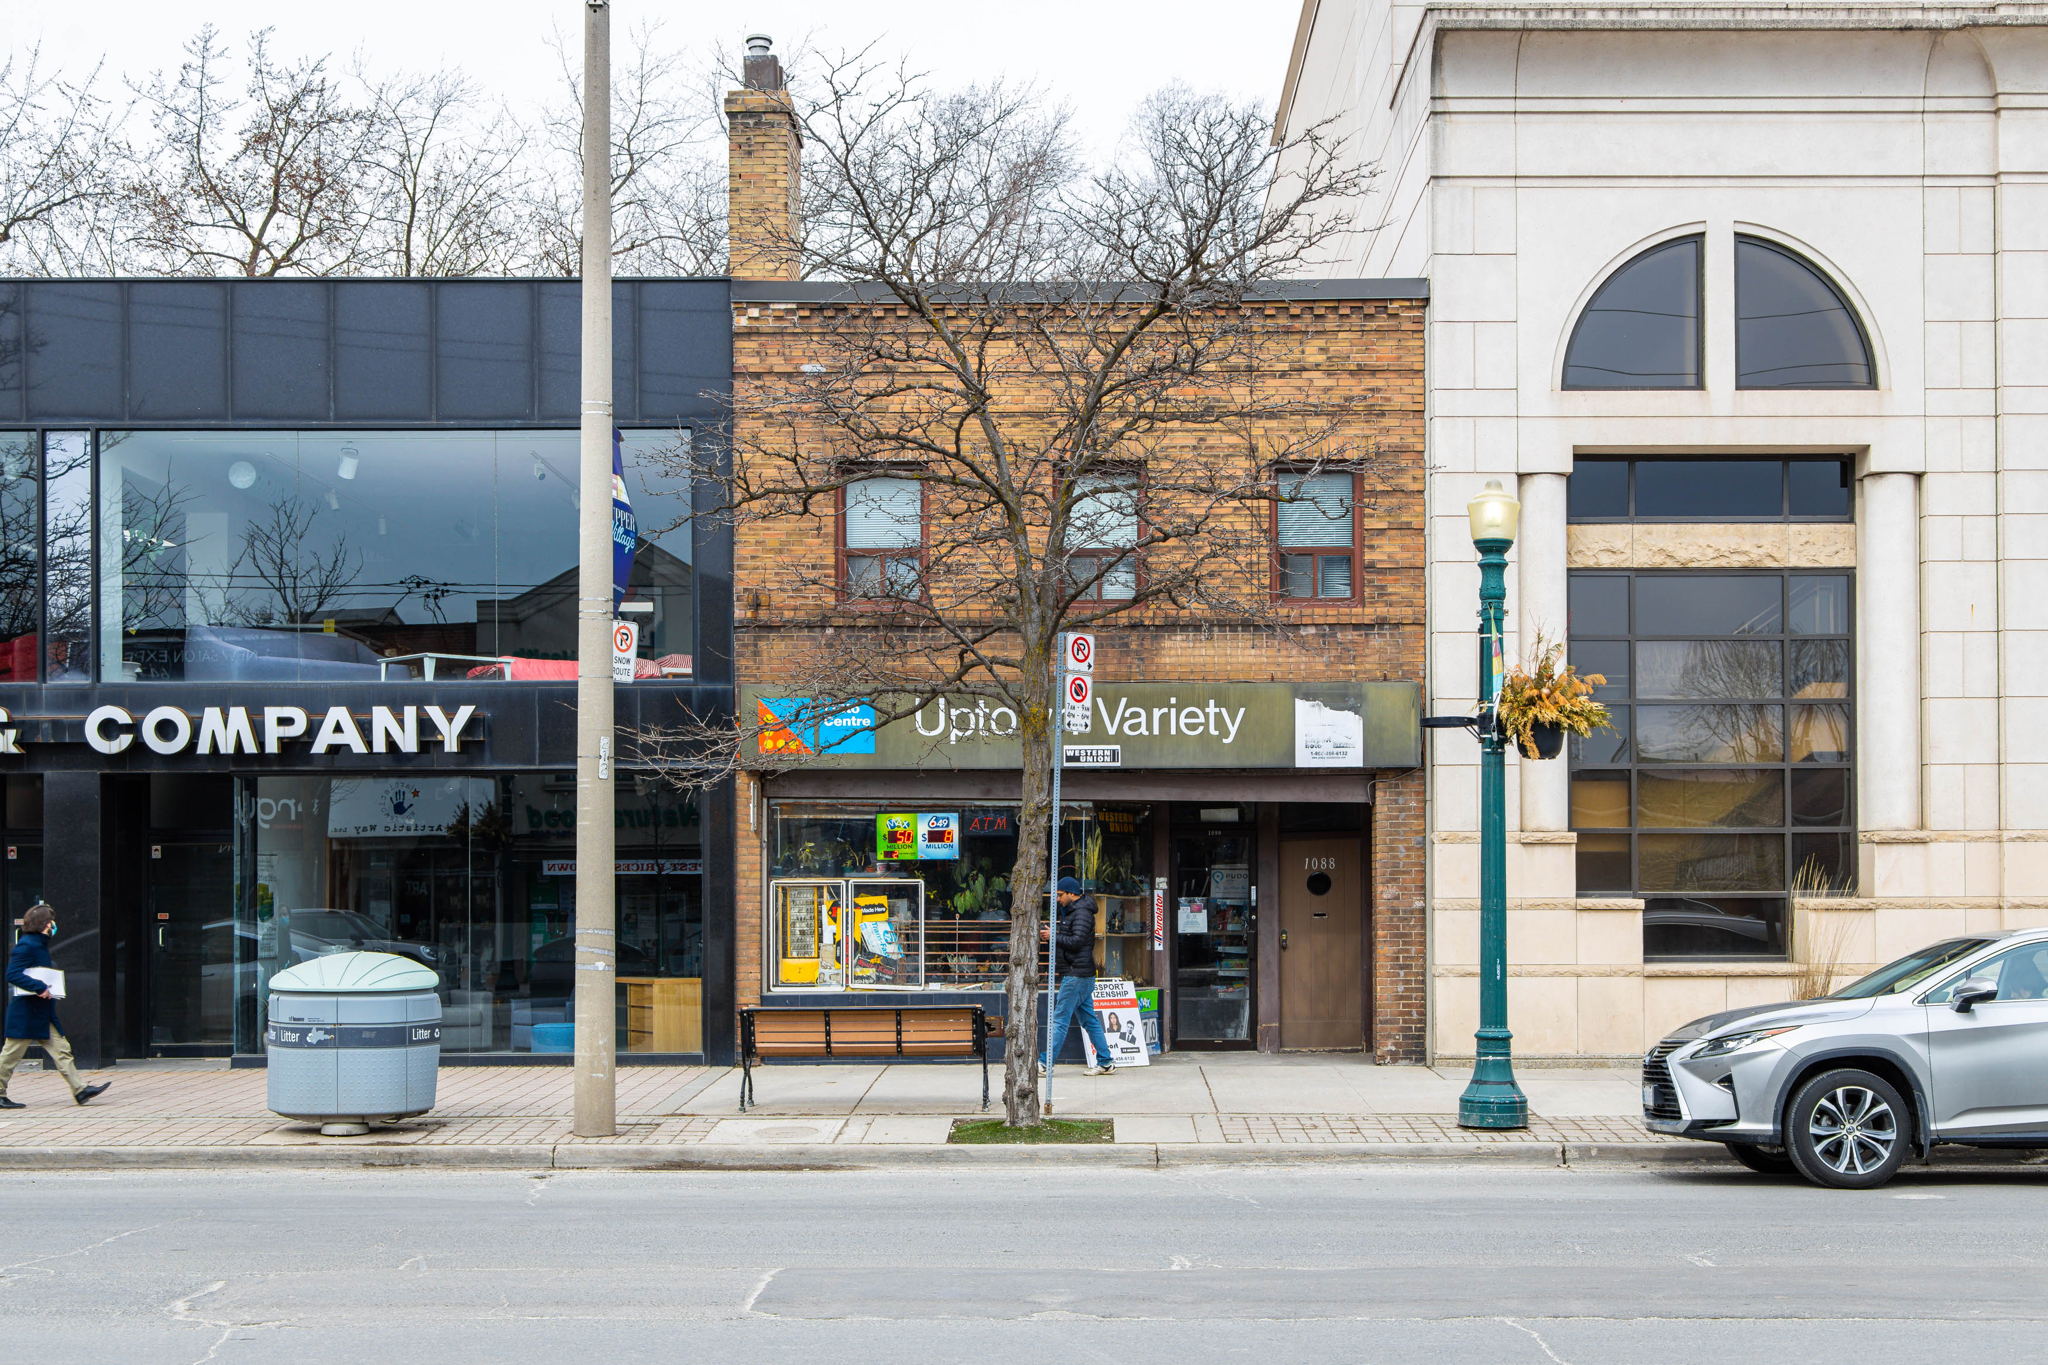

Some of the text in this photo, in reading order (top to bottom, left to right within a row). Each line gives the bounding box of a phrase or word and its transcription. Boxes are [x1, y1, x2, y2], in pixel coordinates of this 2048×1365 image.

[613, 507, 636, 532] PPER
[614, 655, 631, 665] SNOW
[823, 716, 871, 727] Centre
[1096, 697, 1246, 743] Variety
[84, 705, 476, 755] COMPANY
[1066, 749, 1111, 757] WESTERN
[969, 816, 1007, 831] ATM
[896, 829, 914, 844] 50
[944, 829, 953, 844] 8
[1304, 857, 1336, 870] 1088
[1154, 893, 1163, 937] Purolator
[1093, 990, 1129, 998] IZENSHIP
[280, 1029, 300, 1043] Litter
[412, 1028, 431, 1041] Litter
